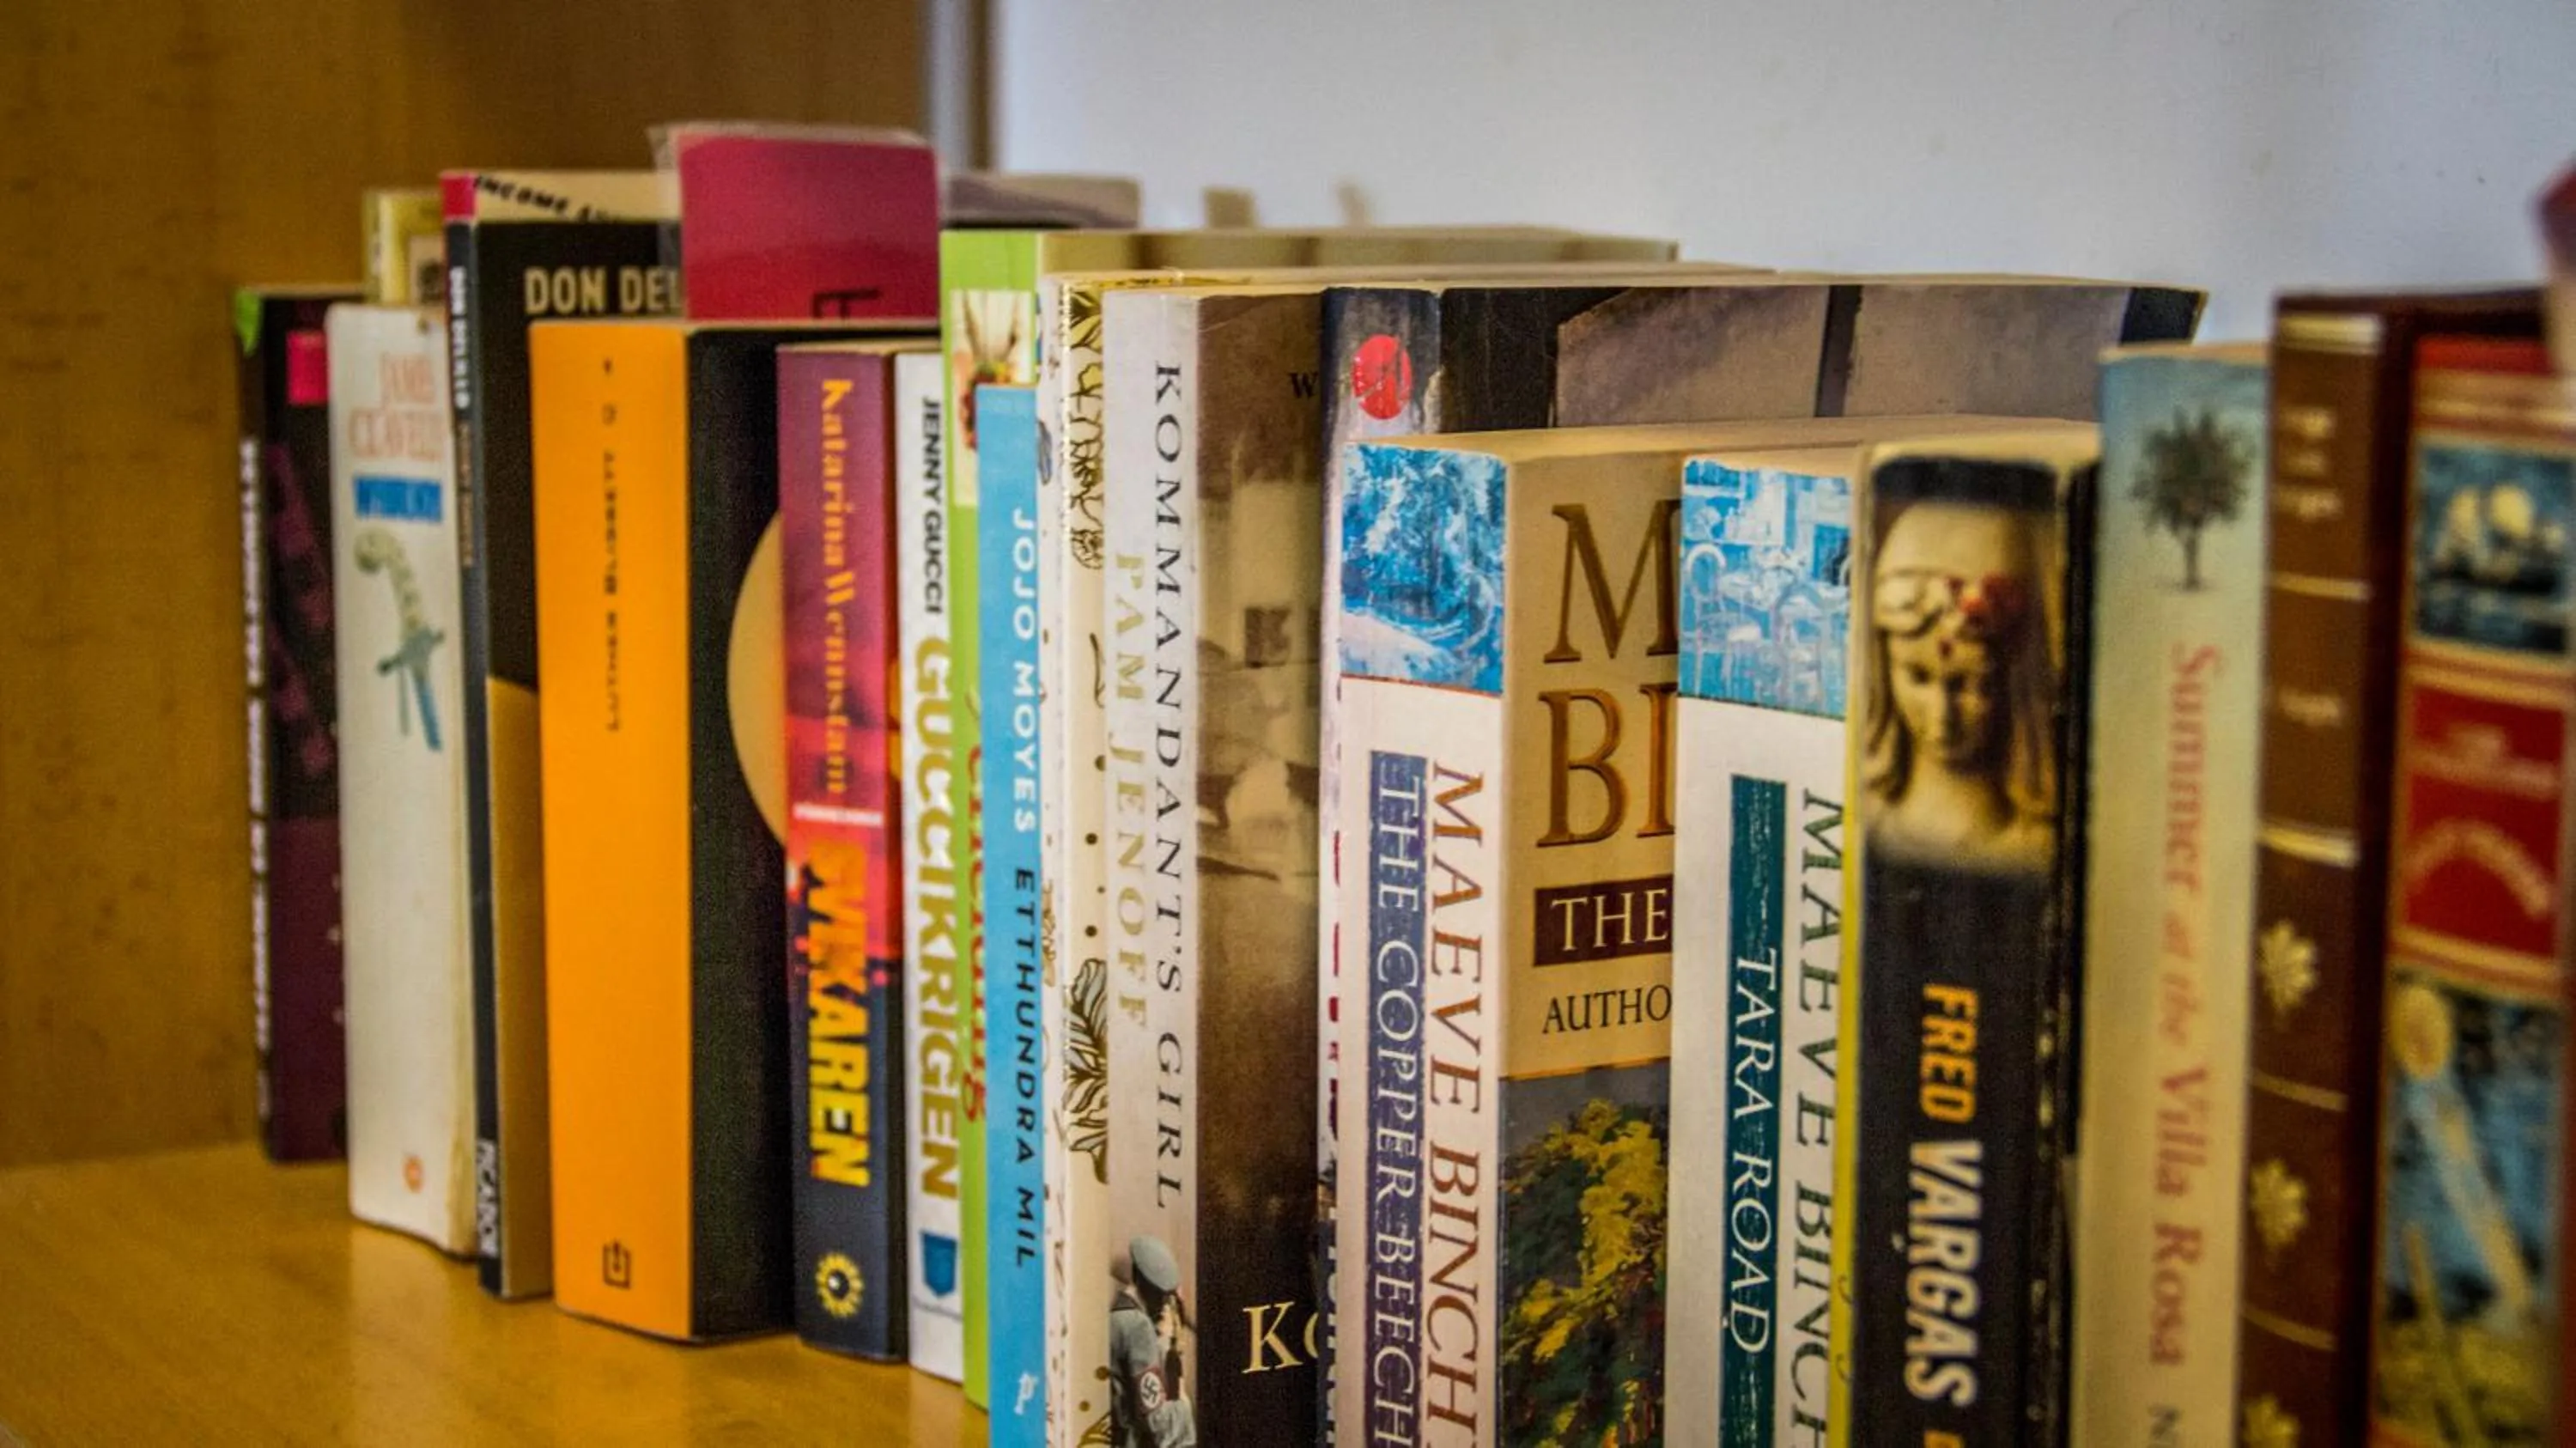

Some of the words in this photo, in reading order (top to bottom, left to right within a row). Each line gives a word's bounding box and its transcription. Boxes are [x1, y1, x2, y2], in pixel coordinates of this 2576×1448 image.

[525, 267, 605, 315] DON
[822, 378, 854, 567] Katarina
[922, 397, 941, 507] JENNY
[923, 509, 944, 615] GUCCI
[1012, 508, 1036, 642] JOJO
[1115, 553, 1146, 702] PAM
[1012, 660, 1037, 833] MOYES
[1154, 361, 1183, 993] KOMMANDANT'S
[1377, 776, 1421, 913] THE
[1534, 682, 1678, 849] BI
[914, 636, 961, 1201] GUCCIKRIGEN
[1108, 730, 1149, 1029] JENOFF
[1429, 759, 1485, 1113] MAEVE
[1551, 888, 1668, 952] THE
[1016, 867, 1036, 1165] ETTHUNDRA
[1733, 947, 1777, 1119] TARA
[1794, 788, 1844, 1148] MAEVE
[1920, 983, 1979, 1123] FRED
[1156, 1032, 1184, 1208] GIRL
[1376, 939, 1419, 1204] COPPER
[1016, 1186, 1036, 1269] MIL
[1426, 1141, 1481, 1448] BINCH
[1729, 1151, 1775, 1355] ROAD
[1905, 1137, 1984, 1408] VARGAS
[1242, 1301, 1318, 1373] K
[1374, 1229, 1416, 1446] BEECH
